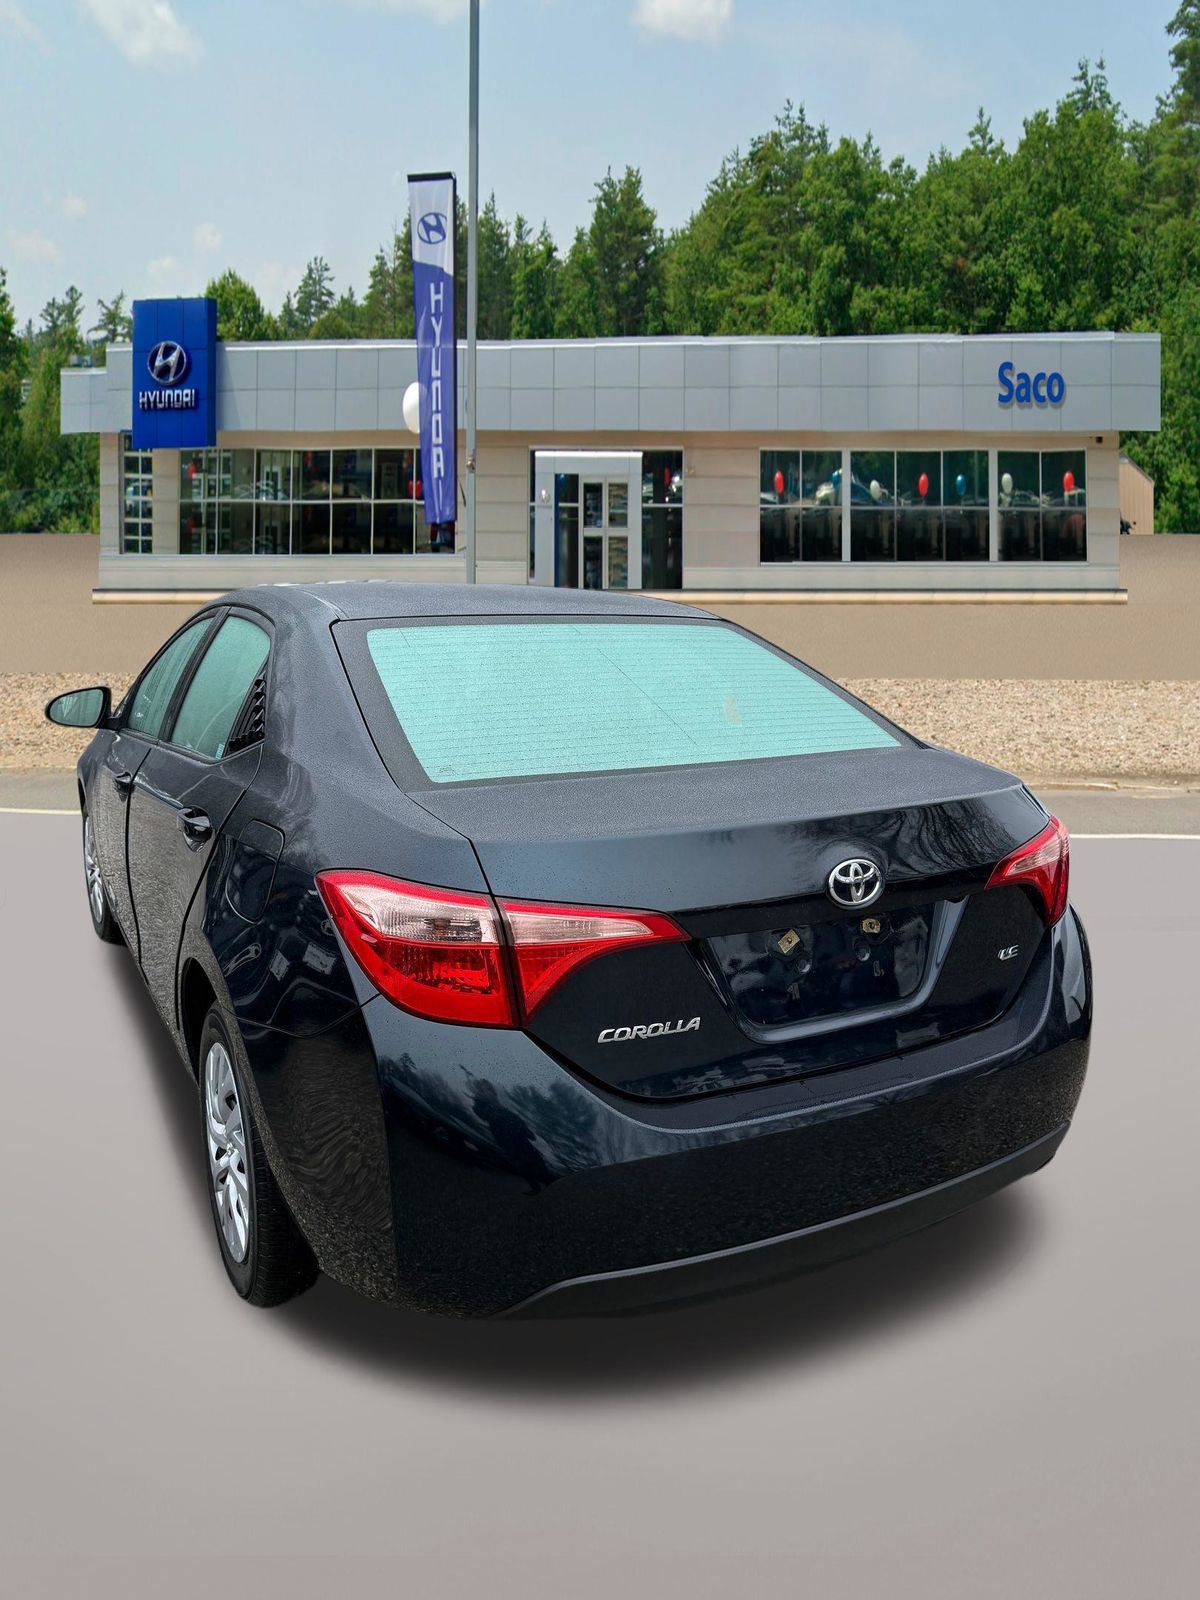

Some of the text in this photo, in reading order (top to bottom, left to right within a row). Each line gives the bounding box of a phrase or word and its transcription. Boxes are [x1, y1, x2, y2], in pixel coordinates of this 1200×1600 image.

[430, 281, 444, 511] HYUNDAI
[998, 361, 1065, 403] Saco
[139, 388, 195, 409] HYUNDAI
[998, 944, 1019, 961] LE
[597, 1016, 701, 1044] COROLLA
